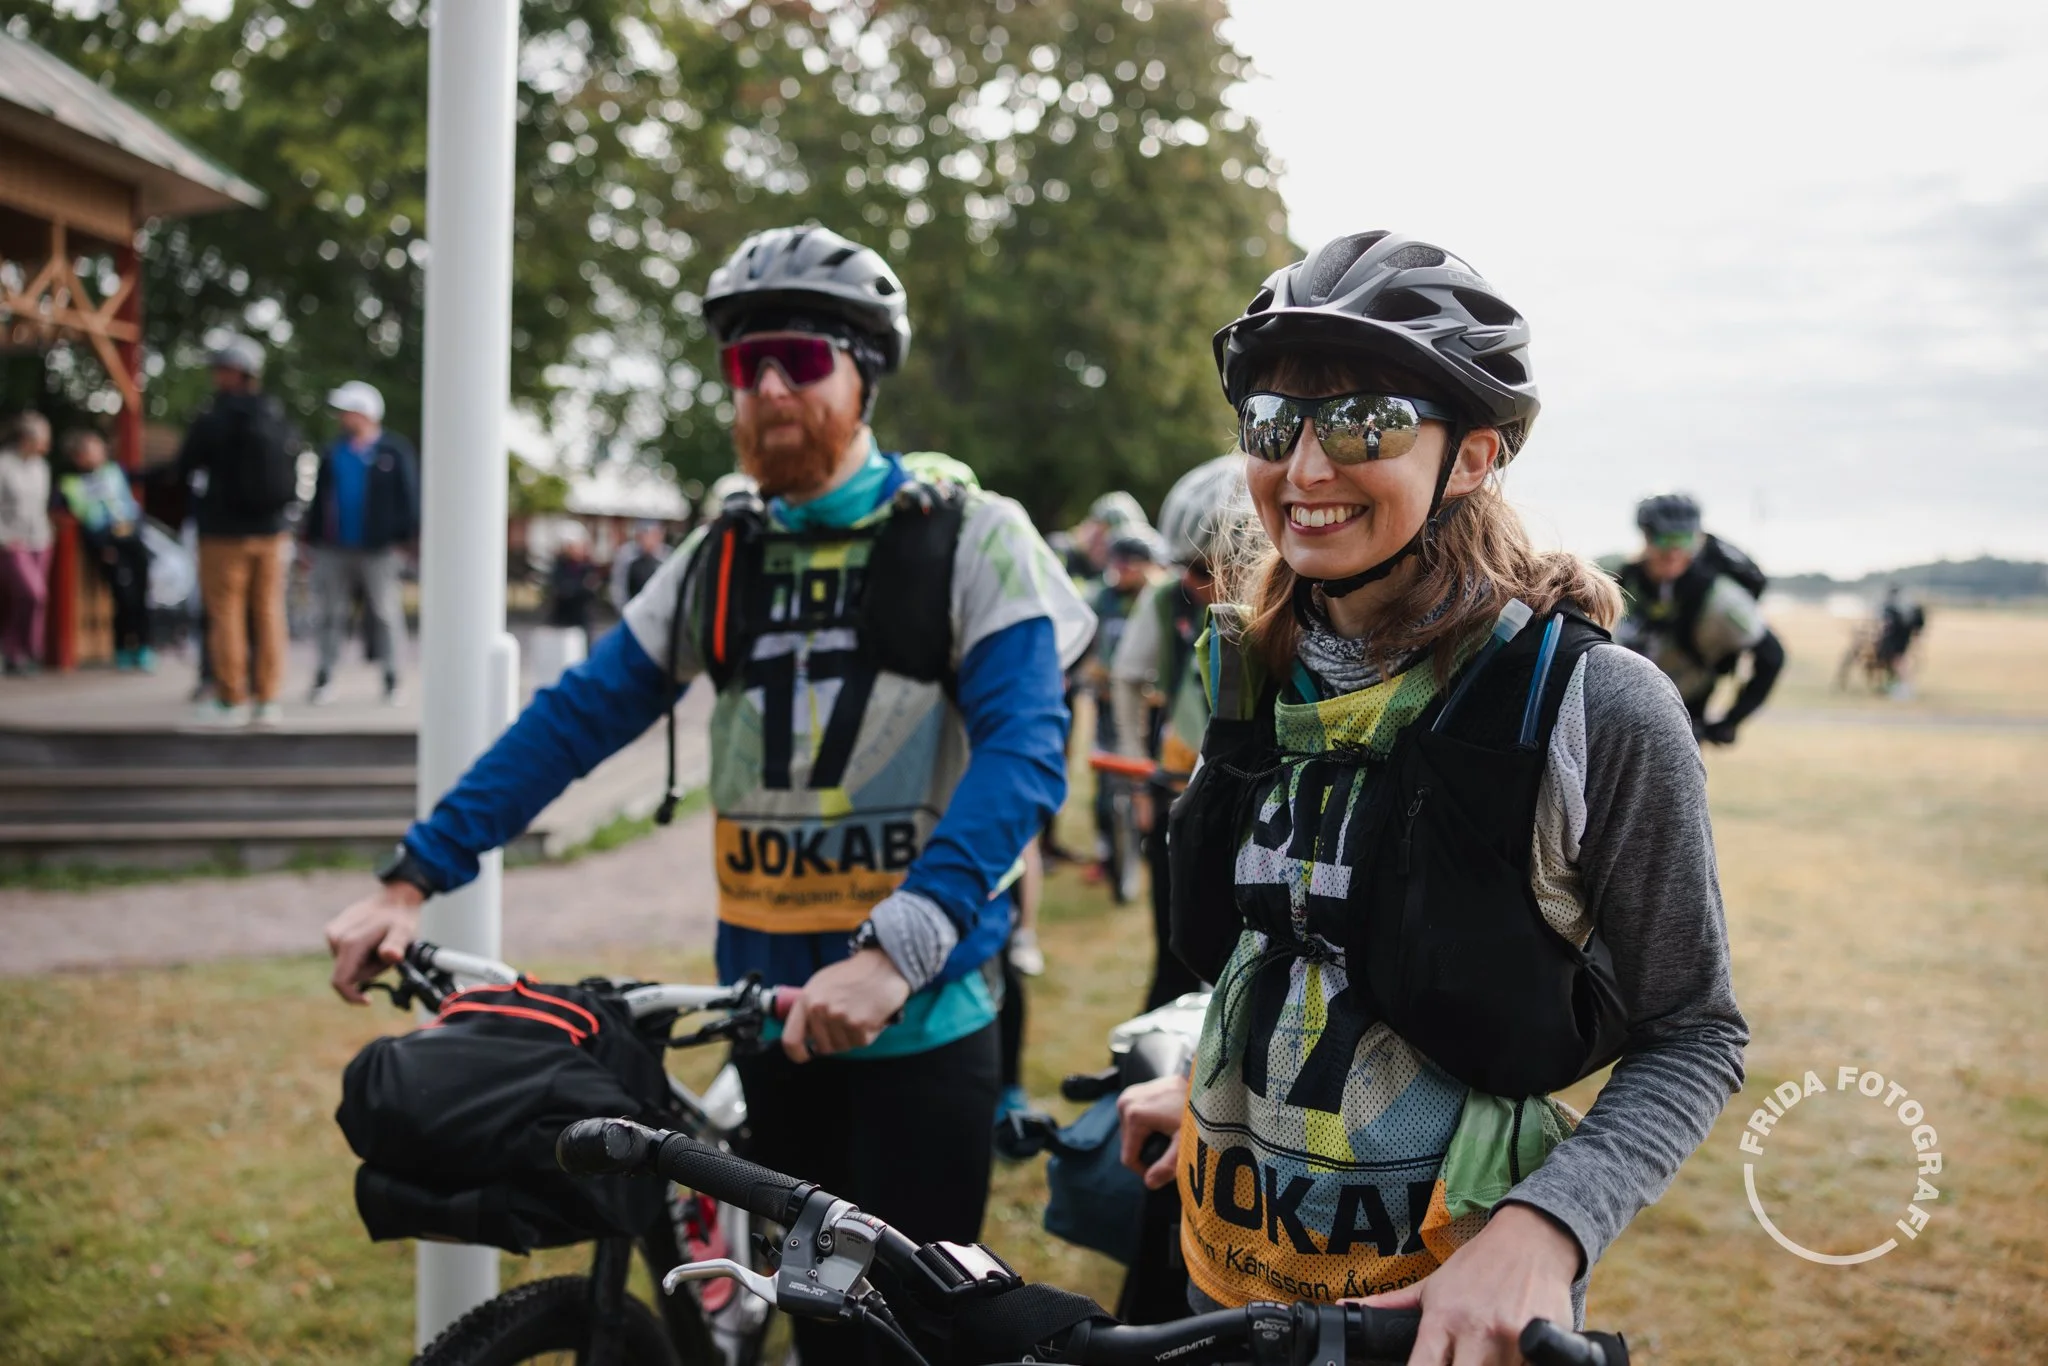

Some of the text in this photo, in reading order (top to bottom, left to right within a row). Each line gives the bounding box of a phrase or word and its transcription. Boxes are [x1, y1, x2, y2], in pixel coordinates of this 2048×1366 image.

[743, 651, 878, 790] 17
[727, 822, 918, 877] JOKAB
[1225, 1243, 1330, 1301] Karlsson
[1155, 1336, 1216, 1363] YOSEMITE
[1253, 1319, 1291, 1334] Deore
